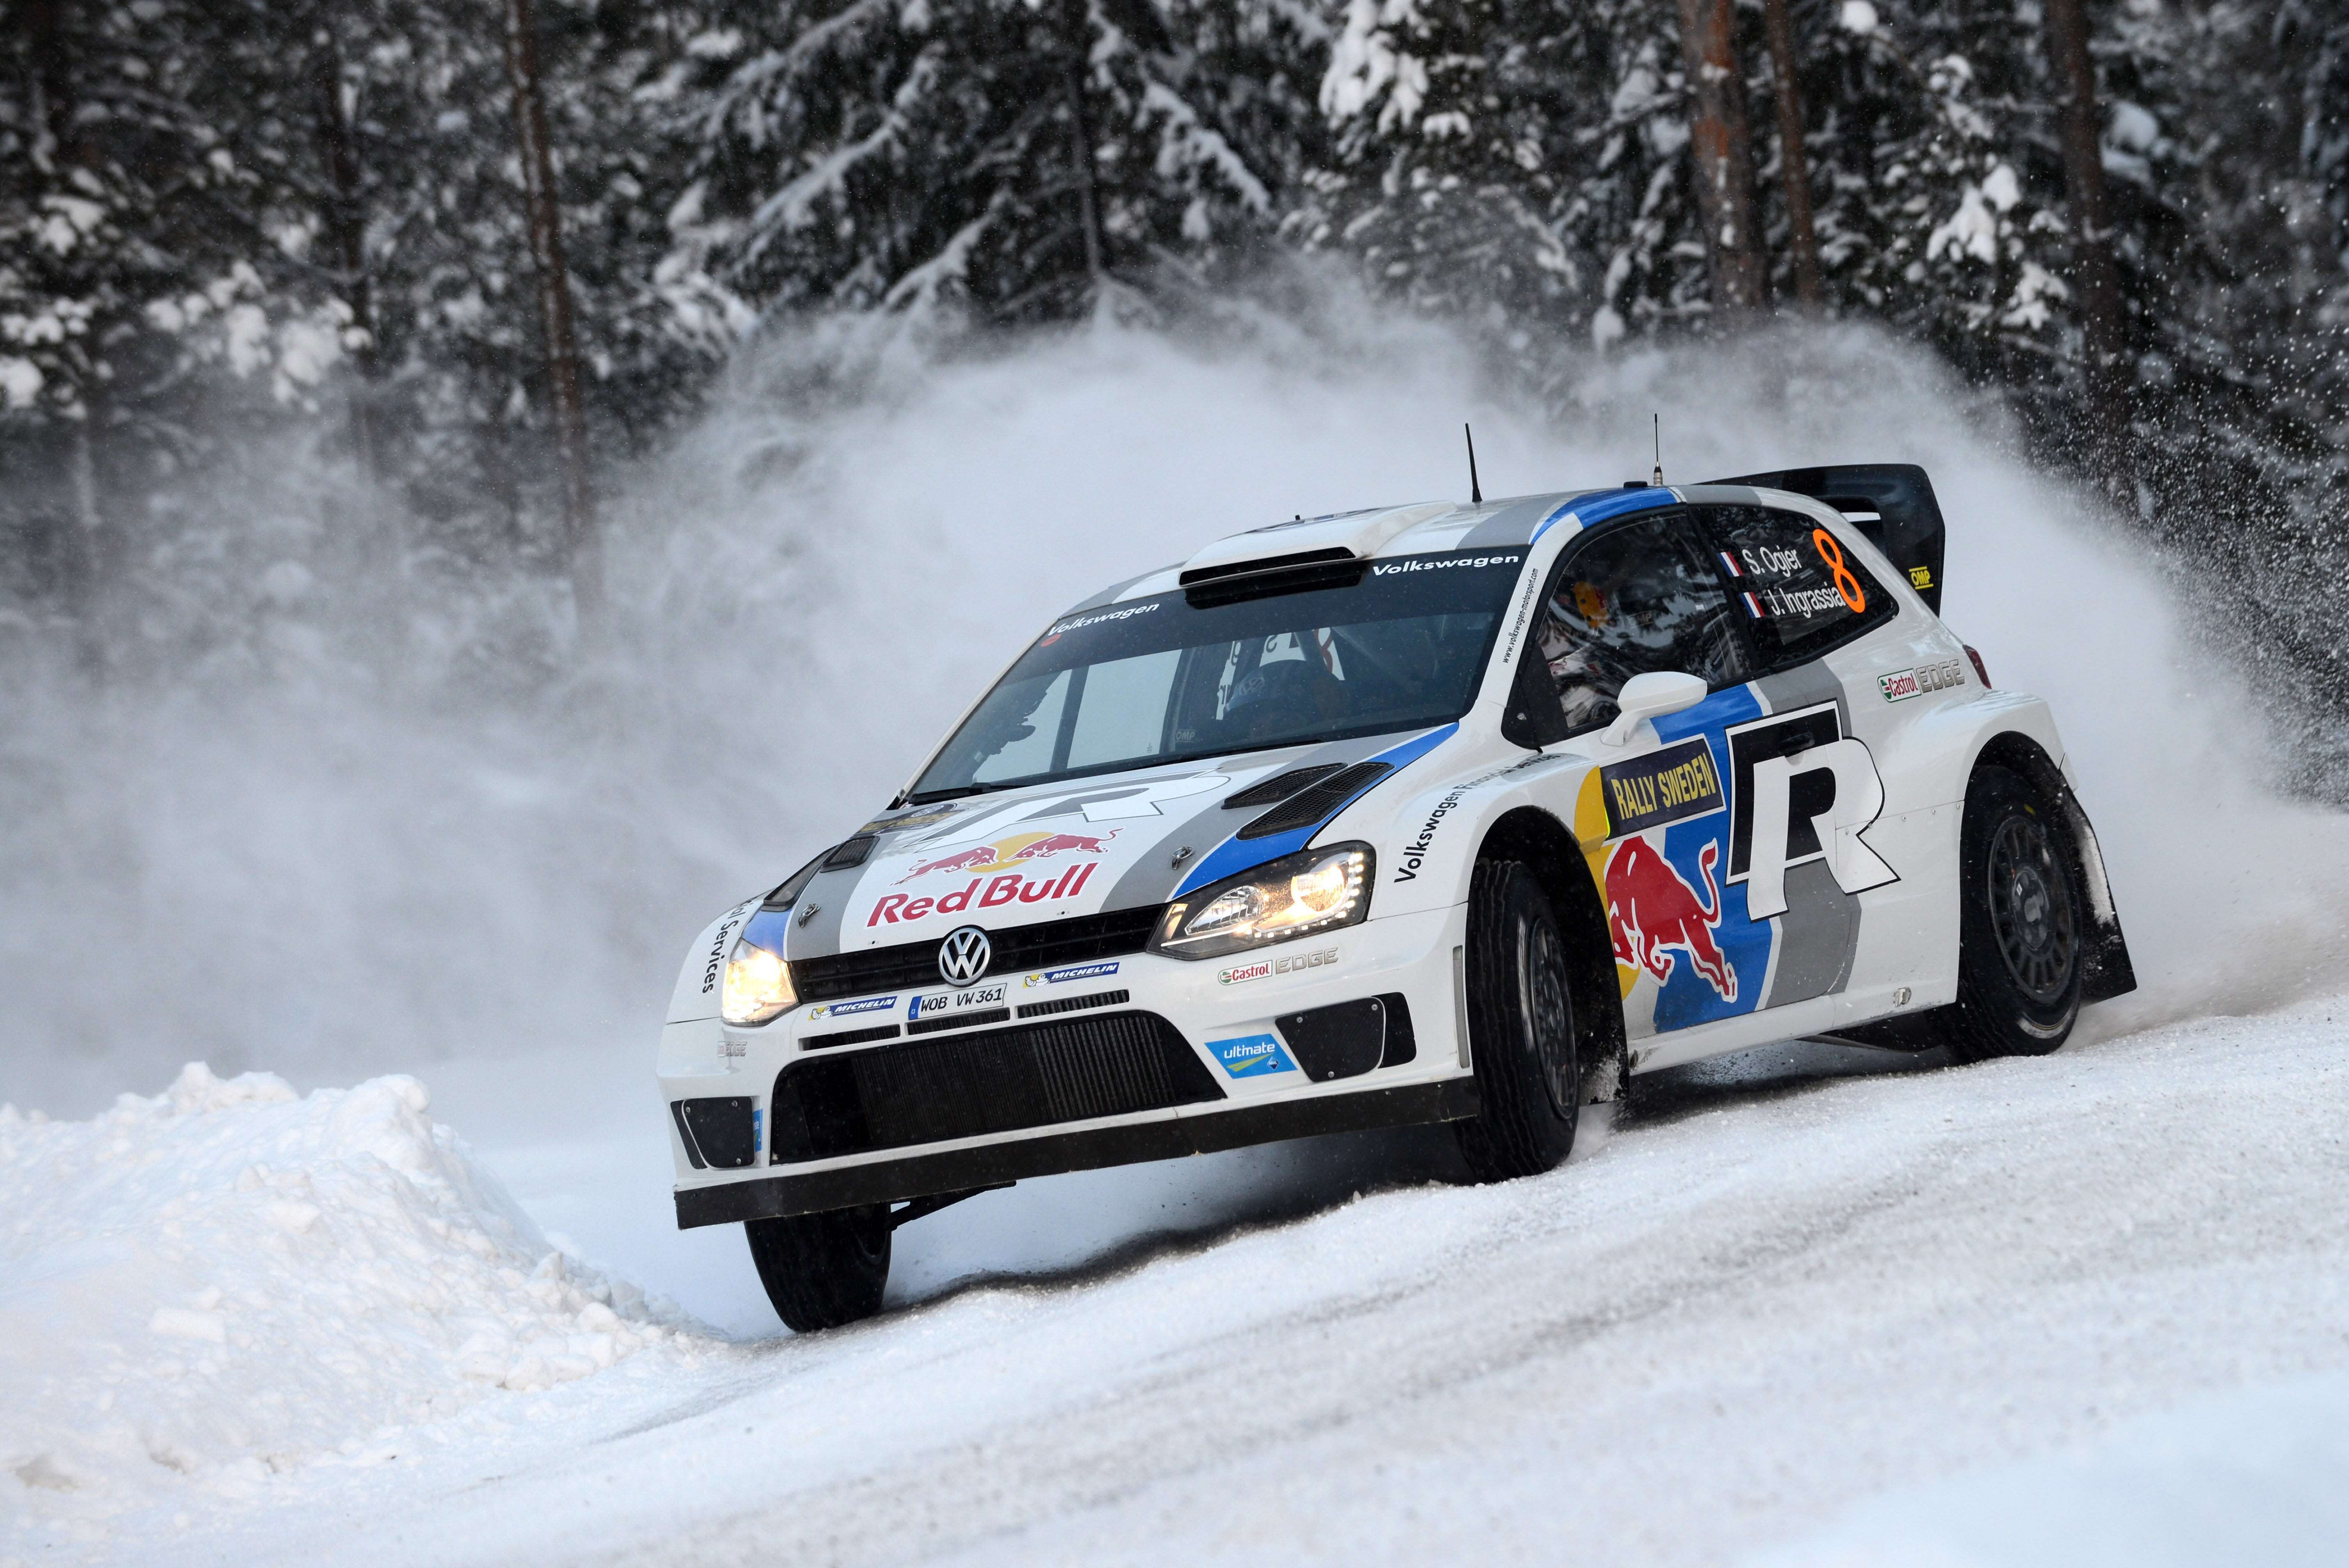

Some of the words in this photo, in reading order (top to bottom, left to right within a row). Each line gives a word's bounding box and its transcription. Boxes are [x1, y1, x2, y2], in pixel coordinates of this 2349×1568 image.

[1372, 554, 1519, 576] Volkswagen
[1742, 549, 1766, 575] S.
[1759, 545, 1801, 578] Ogier
[1813, 529, 1865, 613] 8
[1911, 569, 1930, 585] OMP
[1503, 568, 1538, 663] www.volkswagen-motorsport.com
[1768, 589, 1786, 616] J.
[1786, 581, 1846, 618] Ingrassia
[1048, 604, 1160, 636] Volkswagen
[1888, 672, 1918, 697] Castrol
[1916, 660, 1964, 693] EDGE
[1176, 731, 1195, 741] OMP
[1611, 776, 1657, 820] RALLY
[1662, 753, 1716, 809] SWEDEN
[1394, 786, 1466, 884] Volkswagen
[1738, 732, 1901, 923] R
[867, 878, 979, 927] Red
[978, 862, 1098, 908] Bull
[702, 920, 739, 994] Services
[1051, 964, 1117, 980] MICHELIN
[1231, 962, 1270, 982] Castrol
[1275, 946, 1339, 975] EDGE
[835, 998, 895, 1012] MICHELIN
[921, 996, 948, 1012] WOB
[957, 992, 975, 1006] VW
[976, 988, 1002, 1003] 361
[1224, 1041, 1275, 1059] ultimate
